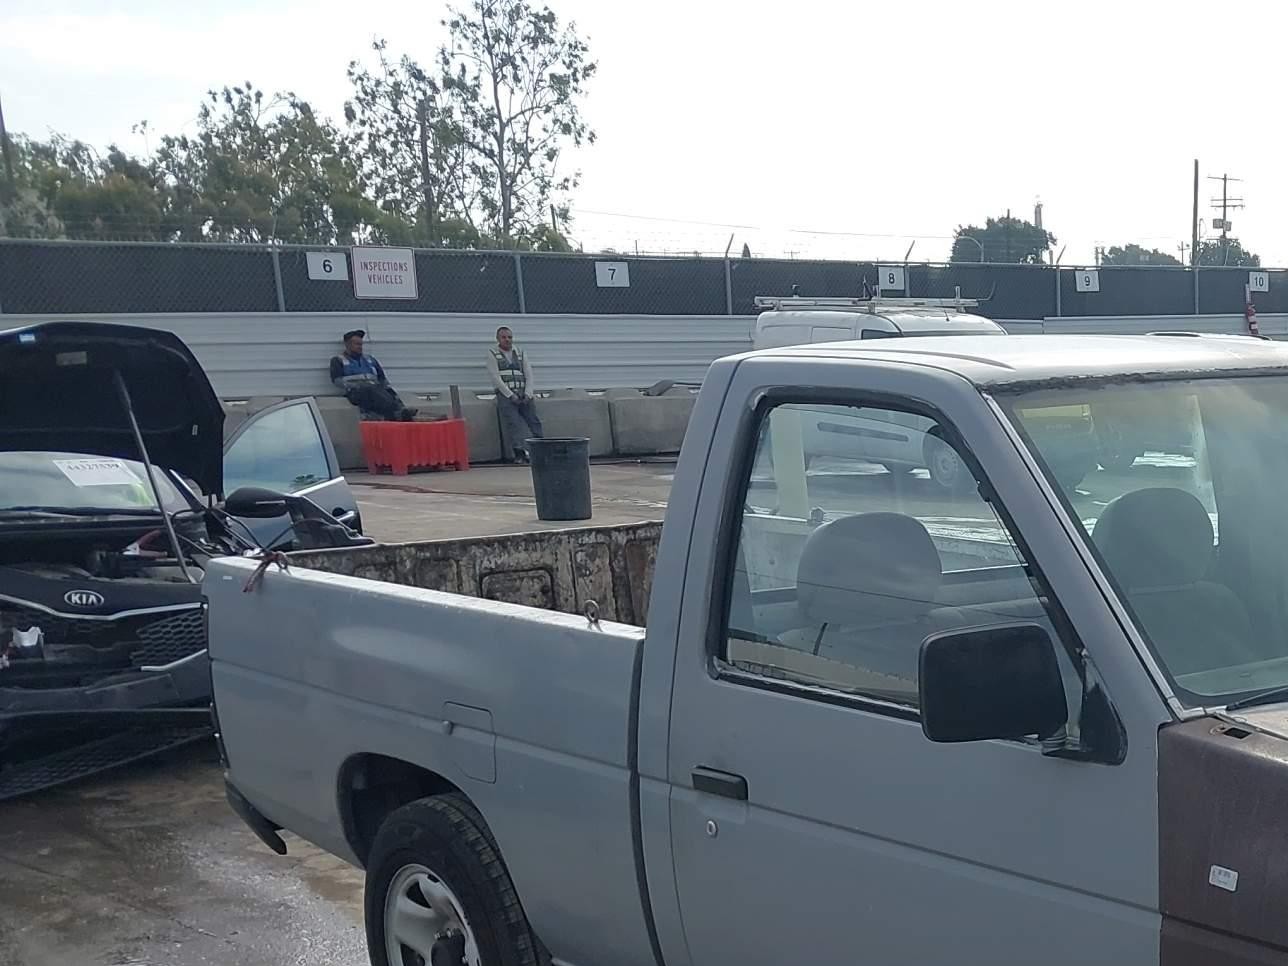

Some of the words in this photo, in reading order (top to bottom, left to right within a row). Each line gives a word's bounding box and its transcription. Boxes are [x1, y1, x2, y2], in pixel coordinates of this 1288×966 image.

[322, 259, 333, 273] 6
[360, 261, 409, 272] INSPECTIONS
[367, 274, 404, 285] VEHICLES
[607, 268, 617, 281] 7
[888, 272, 895, 284] 8
[1084, 275, 1091, 287] 9
[1254, 276, 1264, 287] 10
[71, 593, 99, 605] KIA
